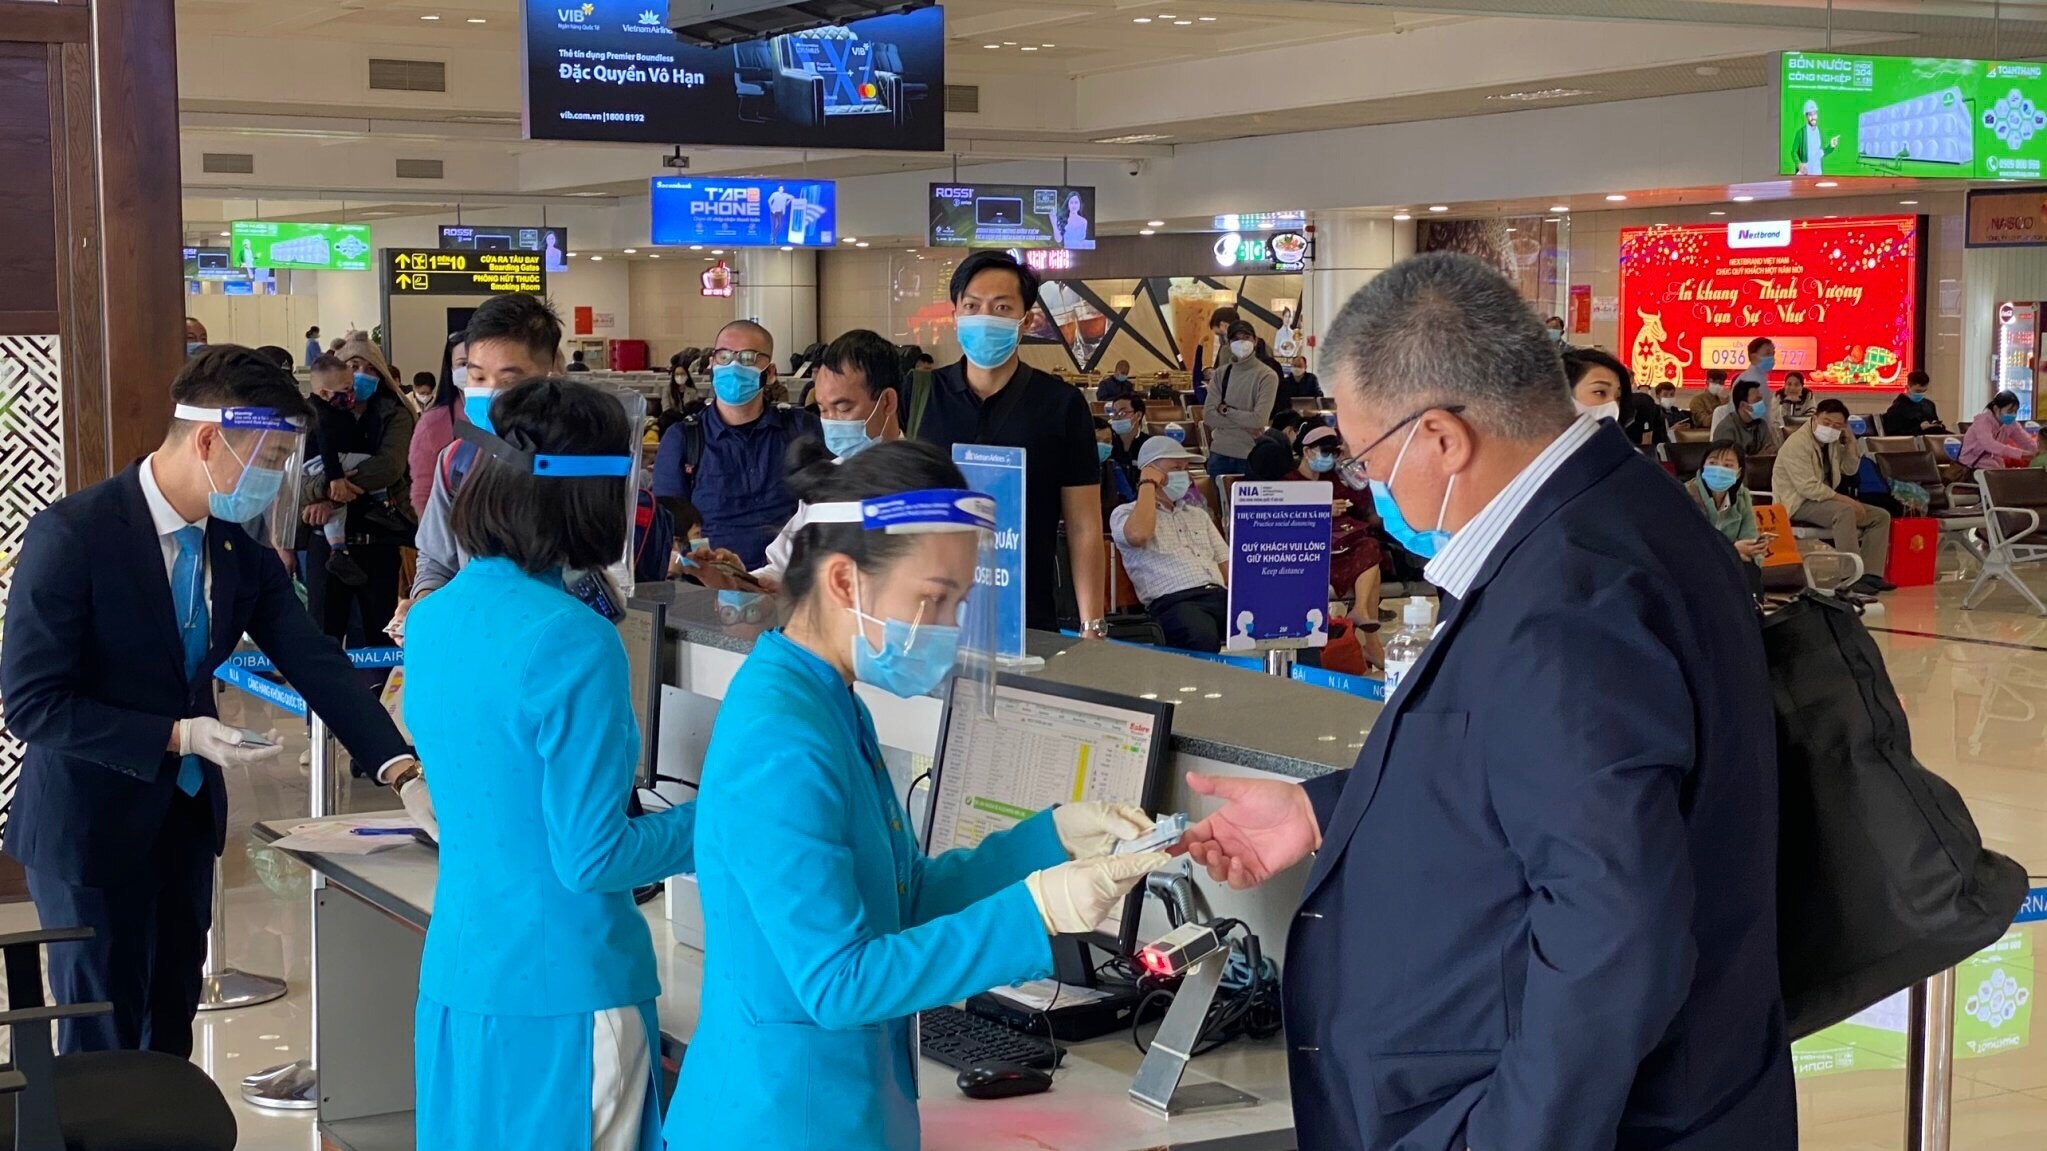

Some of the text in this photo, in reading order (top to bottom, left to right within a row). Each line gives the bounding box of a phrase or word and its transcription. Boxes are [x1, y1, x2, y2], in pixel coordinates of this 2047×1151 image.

[558, 8, 585, 23] VIB
[622, 24, 673, 34] VietnamAirline
[606, 52, 635, 61] Premier
[636, 54, 674, 62] Boundless
[852, 47, 866, 56] VIB
[559, 63, 705, 88] Đặc Quyền Vô Hạn
[625, 113, 645, 122] 8192
[690, 201, 761, 216] PHONE
[1738, 229, 1781, 240] Nextbrand
[450, 255, 466, 270] 10
[524, 256, 540, 264] BAY
[489, 263, 540, 273] Boarding Gates
[490, 283, 541, 292] Smoking Room
[1696, 279, 1739, 307] khang
[1802, 276, 1863, 306] Vượng
[1692, 302, 1731, 327] Vạn
[1711, 349, 1806, 366] 0936 727
[1238, 486, 1259, 497] NIA
[1241, 540, 1326, 553] QUÝ KHÁCH VUI LÒNG
[1246, 551, 1321, 564] GIỮ KHOẢNG CÁCH
[1261, 567, 1305, 576] Keep distance
[229, 655, 270, 668] OIBA
